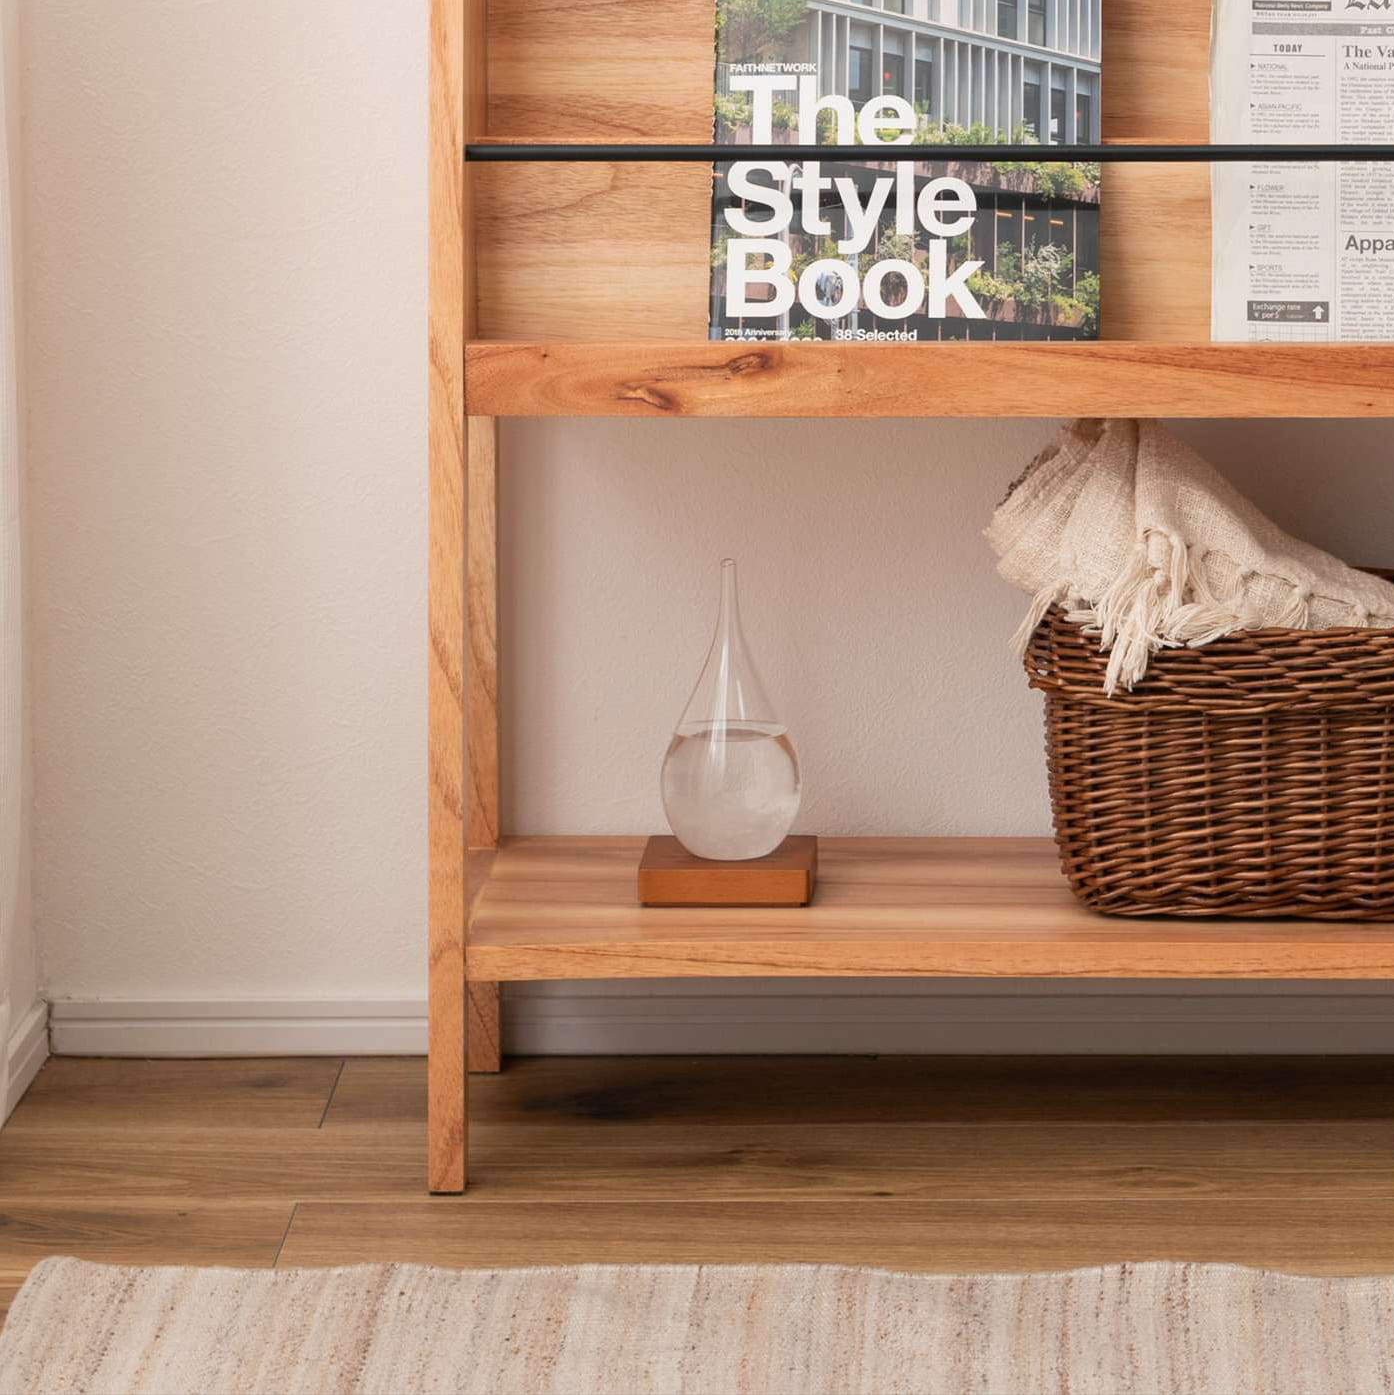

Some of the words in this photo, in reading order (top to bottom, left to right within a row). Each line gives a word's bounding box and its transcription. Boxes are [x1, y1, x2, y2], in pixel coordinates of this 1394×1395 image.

[1360, 26, 1383, 34] Fast
[1273, 44, 1303, 53] TODAY
[1342, 45, 1372, 58] The
[729, 63, 817, 72] FAITHNETWORK
[1353, 62, 1385, 71] National
[729, 75, 915, 145] The
[723, 161, 977, 254] Style
[725, 238, 986, 320] Book
[1252, 303, 1286, 311] Exchange
[724, 328, 743, 336] 20th
[744, 328, 793, 339] Anniversary
[835, 329, 853, 341] 38
[856, 329, 917, 341] Selected
